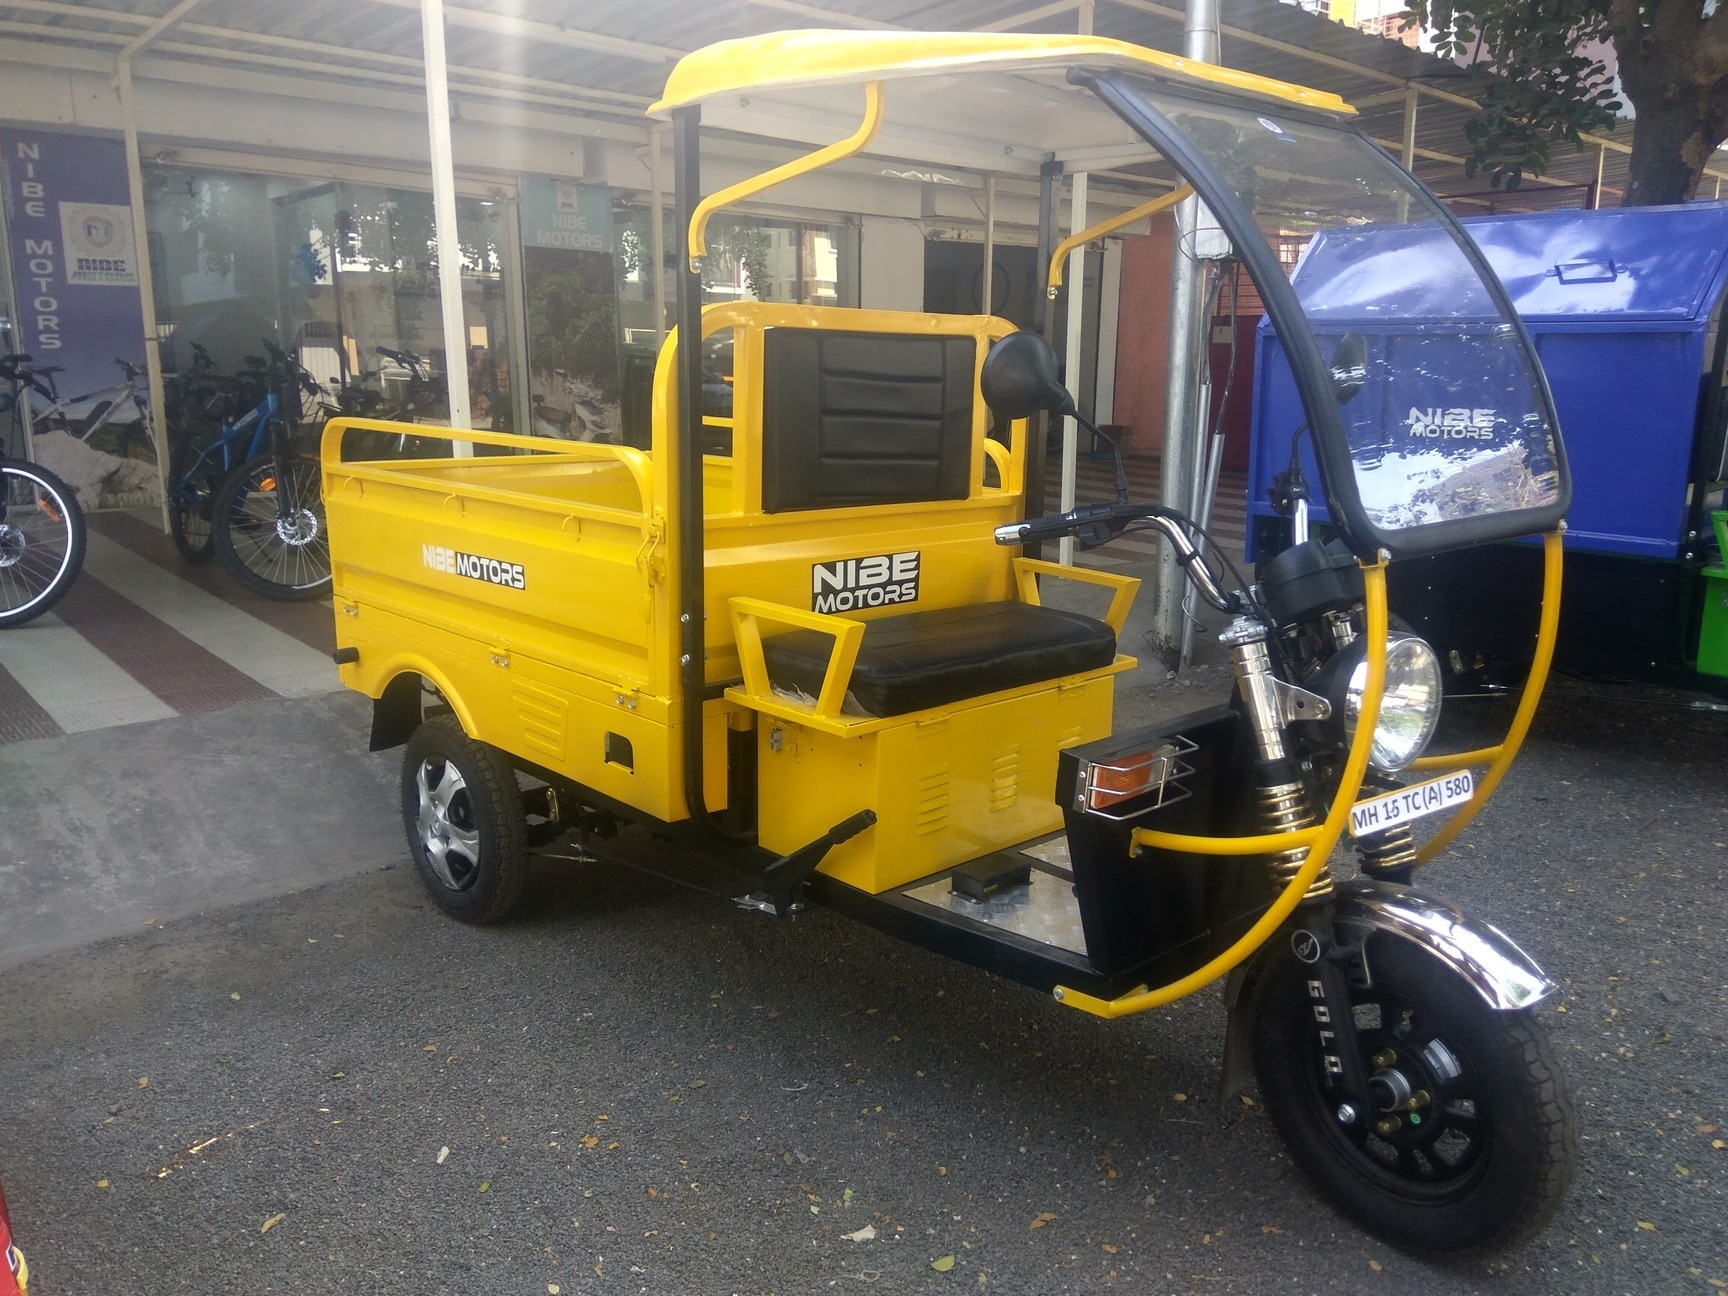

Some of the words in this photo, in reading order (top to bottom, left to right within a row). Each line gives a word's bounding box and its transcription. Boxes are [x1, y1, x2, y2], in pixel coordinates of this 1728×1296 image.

[17, 142, 45, 218] NIBE
[537, 230, 602, 248] MOTORS
[553, 215, 587, 230] NIBE
[25, 239, 61, 349] MOTORS
[1408, 407, 1497, 427] NIBE
[1409, 422, 1494, 440] MOTORS
[422, 543, 456, 574] NIBE
[456, 552, 525, 589] MOTORS
[813, 551, 919, 593] NIBE
[814, 582, 916, 613] MOTORS
[1352, 805, 1379, 830] MH
[1445, 775, 1471, 799] 580
